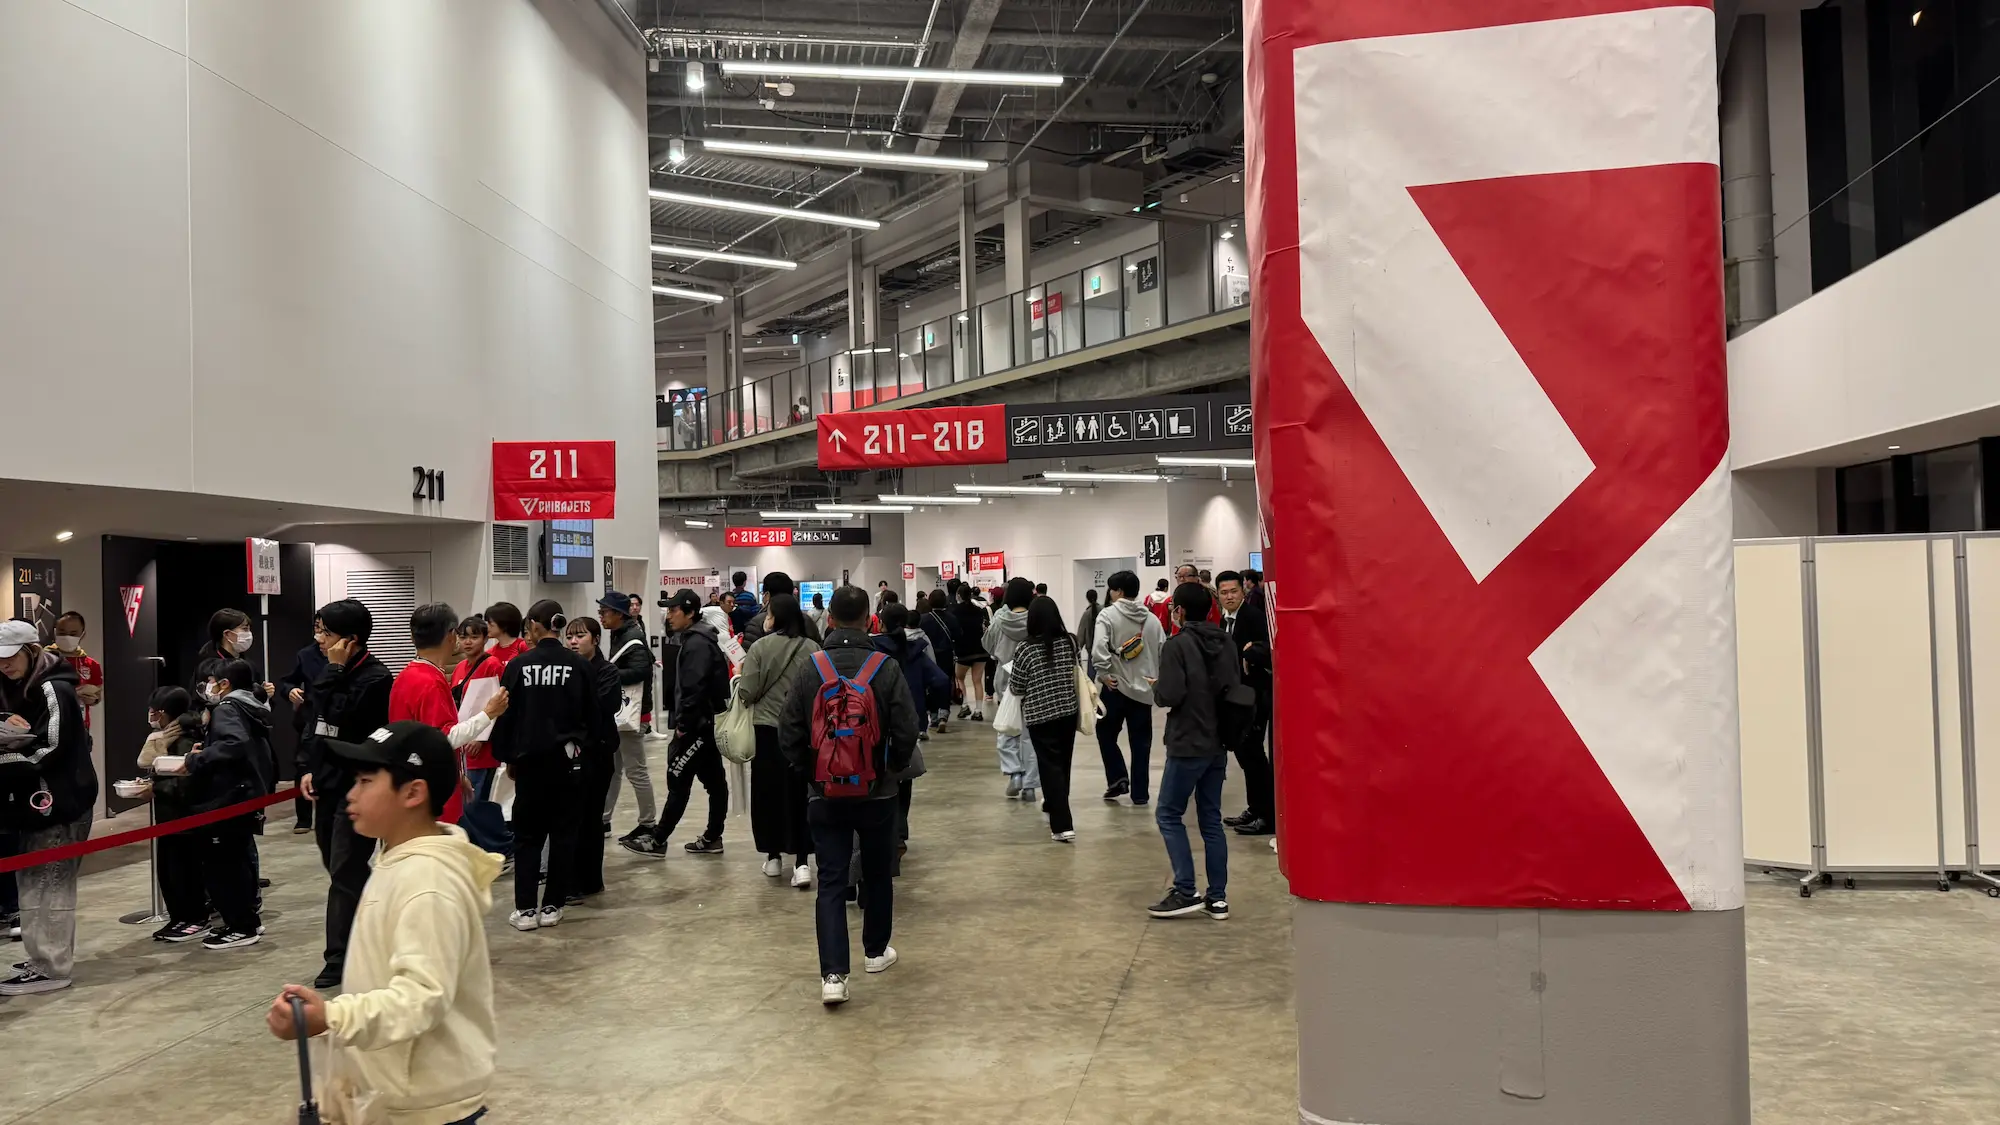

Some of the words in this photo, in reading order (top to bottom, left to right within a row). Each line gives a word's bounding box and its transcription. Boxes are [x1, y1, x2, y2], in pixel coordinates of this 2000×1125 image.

[1227, 265, 1235, 273] 3F
[863, 419, 985, 455] 211-218
[1229, 424, 1251, 433] 1F-2F
[529, 449, 578, 479] 211
[412, 465, 445, 502] 211
[741, 530, 787, 543] 212-218
[18, 567, 32, 583] 211
[1094, 570, 1104, 579] 2F
[521, 664, 573, 687] STAFF
[672, 738, 705, 778] ATHLETA
